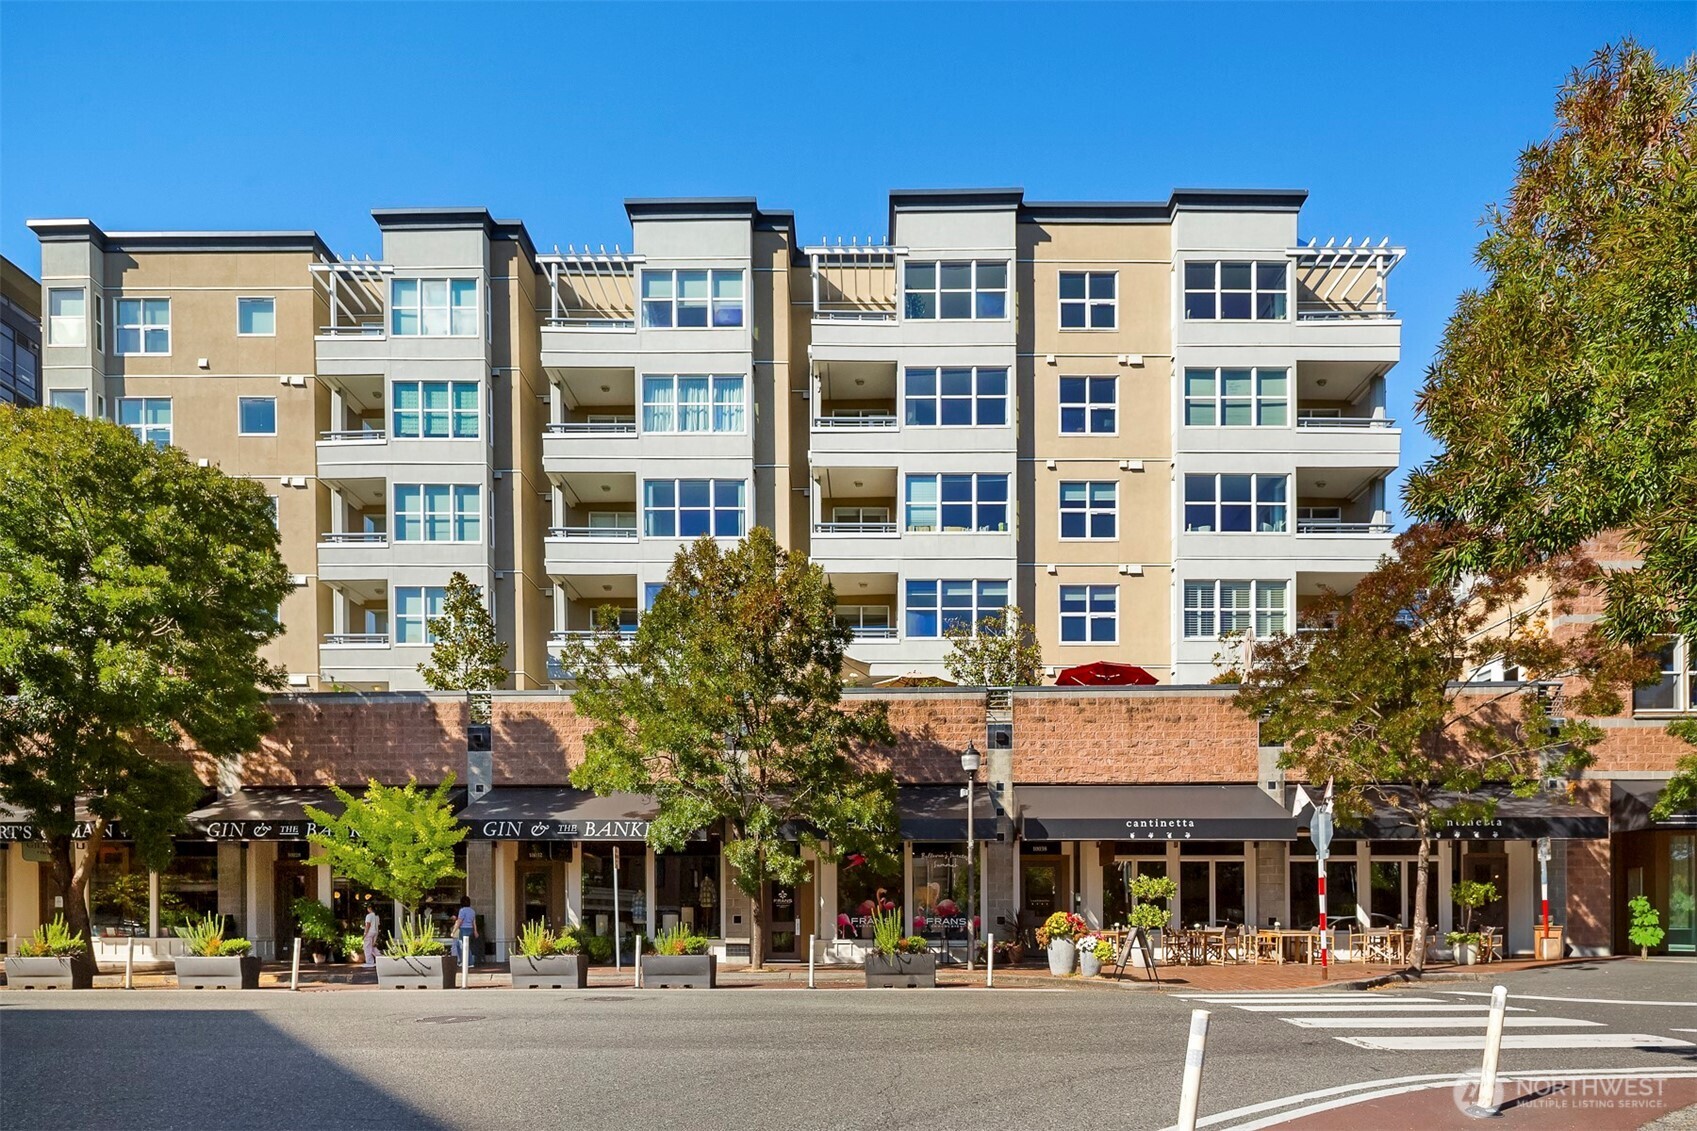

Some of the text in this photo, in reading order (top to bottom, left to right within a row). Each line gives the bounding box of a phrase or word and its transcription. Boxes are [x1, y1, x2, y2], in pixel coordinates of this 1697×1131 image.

[71, 823, 114, 839] MAN
[207, 822, 361, 838] GIN & THE BAK
[483, 821, 523, 837] GIN
[531, 821, 550, 837] &
[557, 824, 578, 834] THE
[1126, 818, 1195, 828] cantinetta
[926, 917, 967, 926] FRANS
